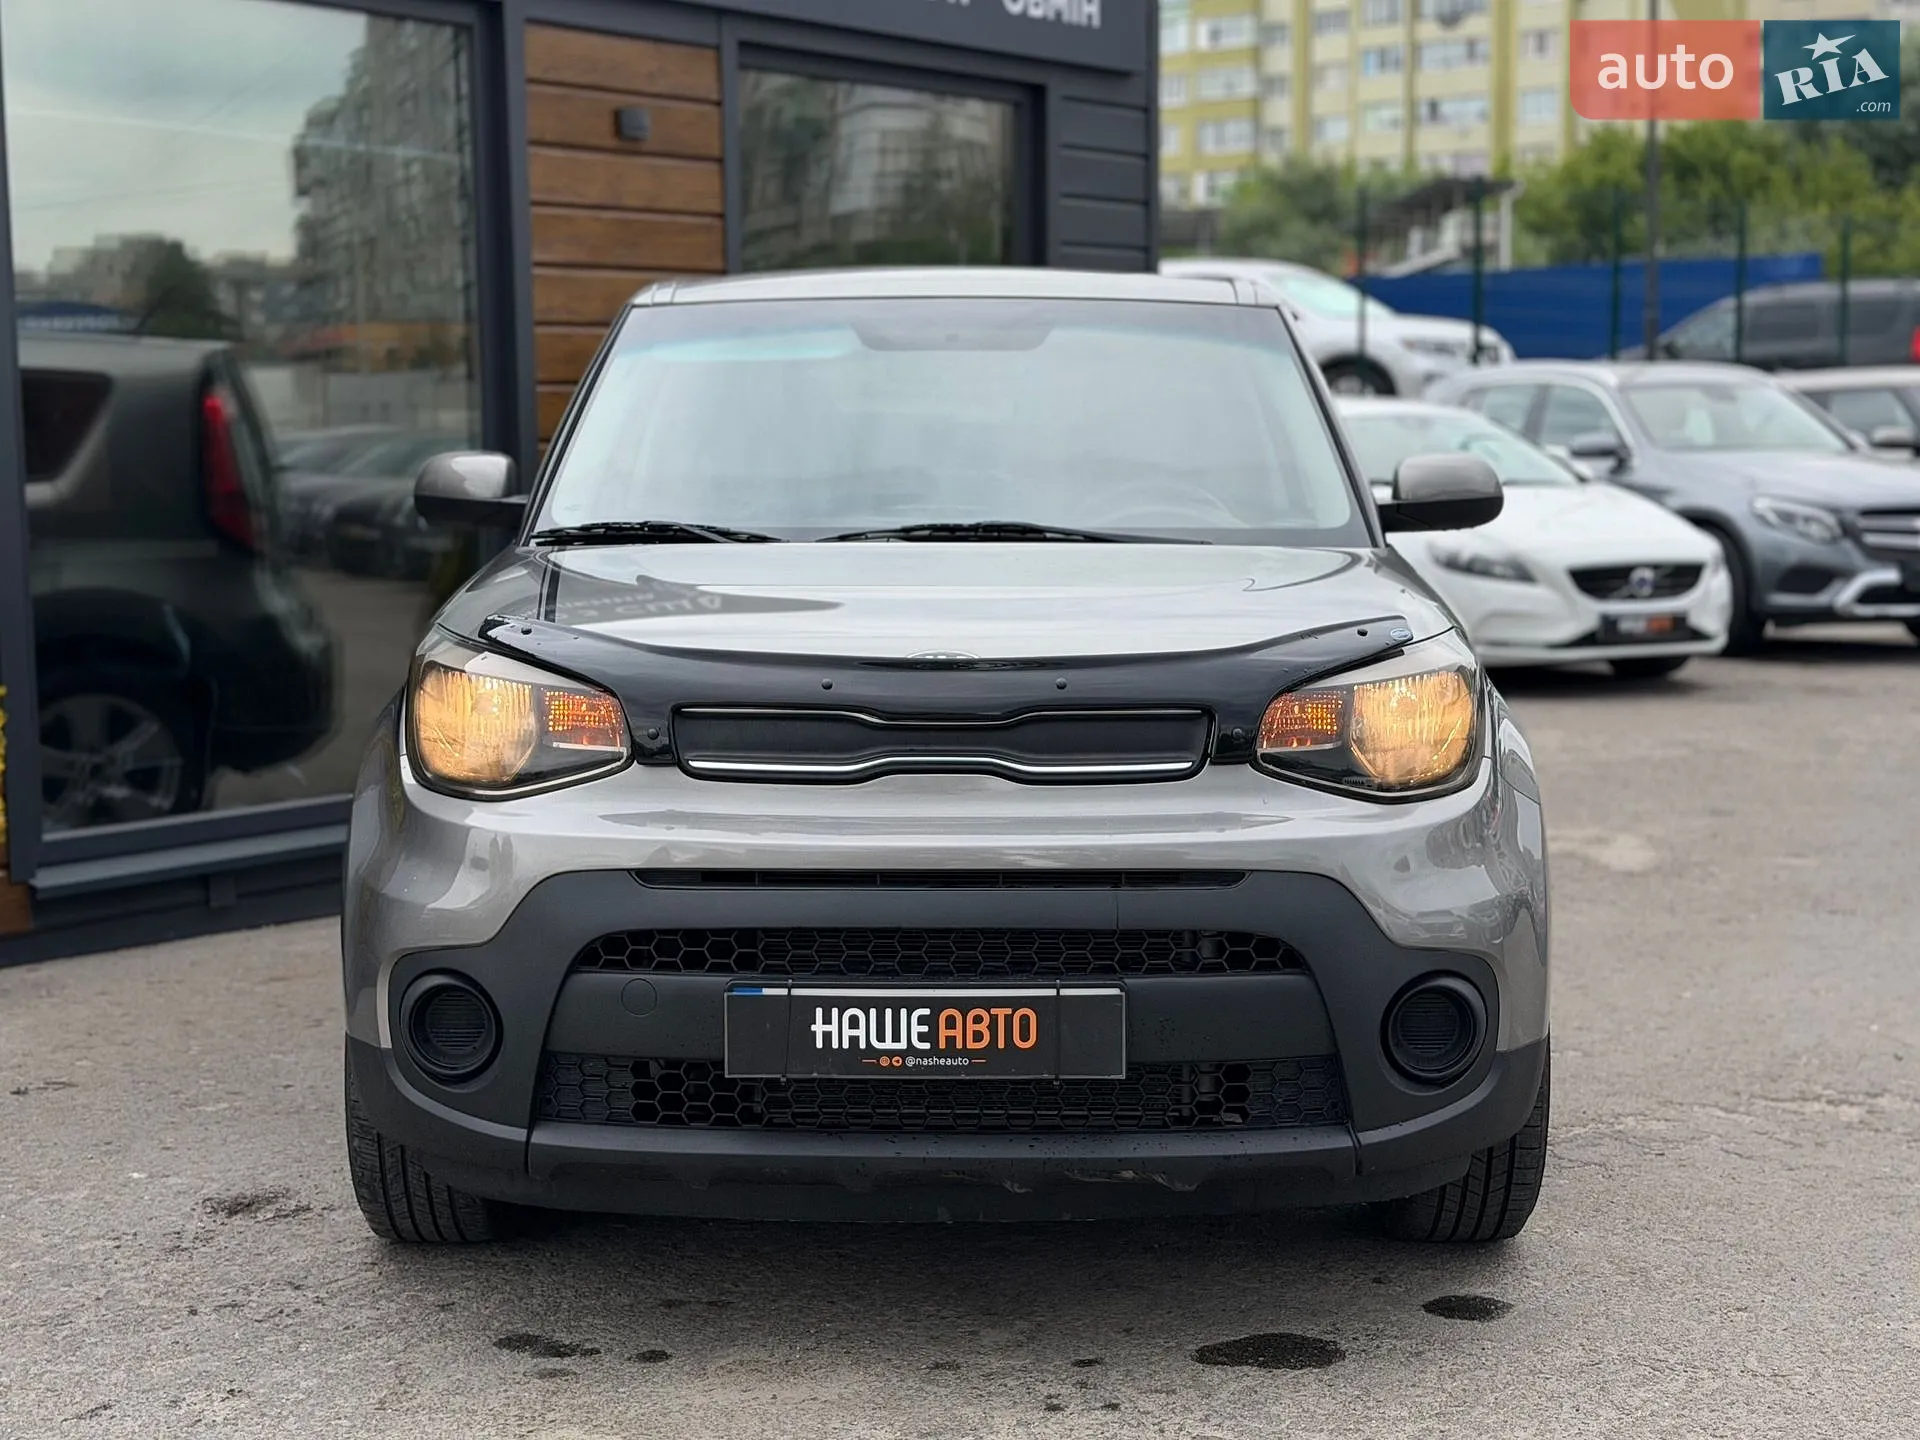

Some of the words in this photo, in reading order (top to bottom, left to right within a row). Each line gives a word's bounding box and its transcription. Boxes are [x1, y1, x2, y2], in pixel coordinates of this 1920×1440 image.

[811, 1007, 931, 1050] НАШЕ
[938, 1007, 1037, 1049] АВТО
[905, 1055, 970, 1067] @nasheauto
